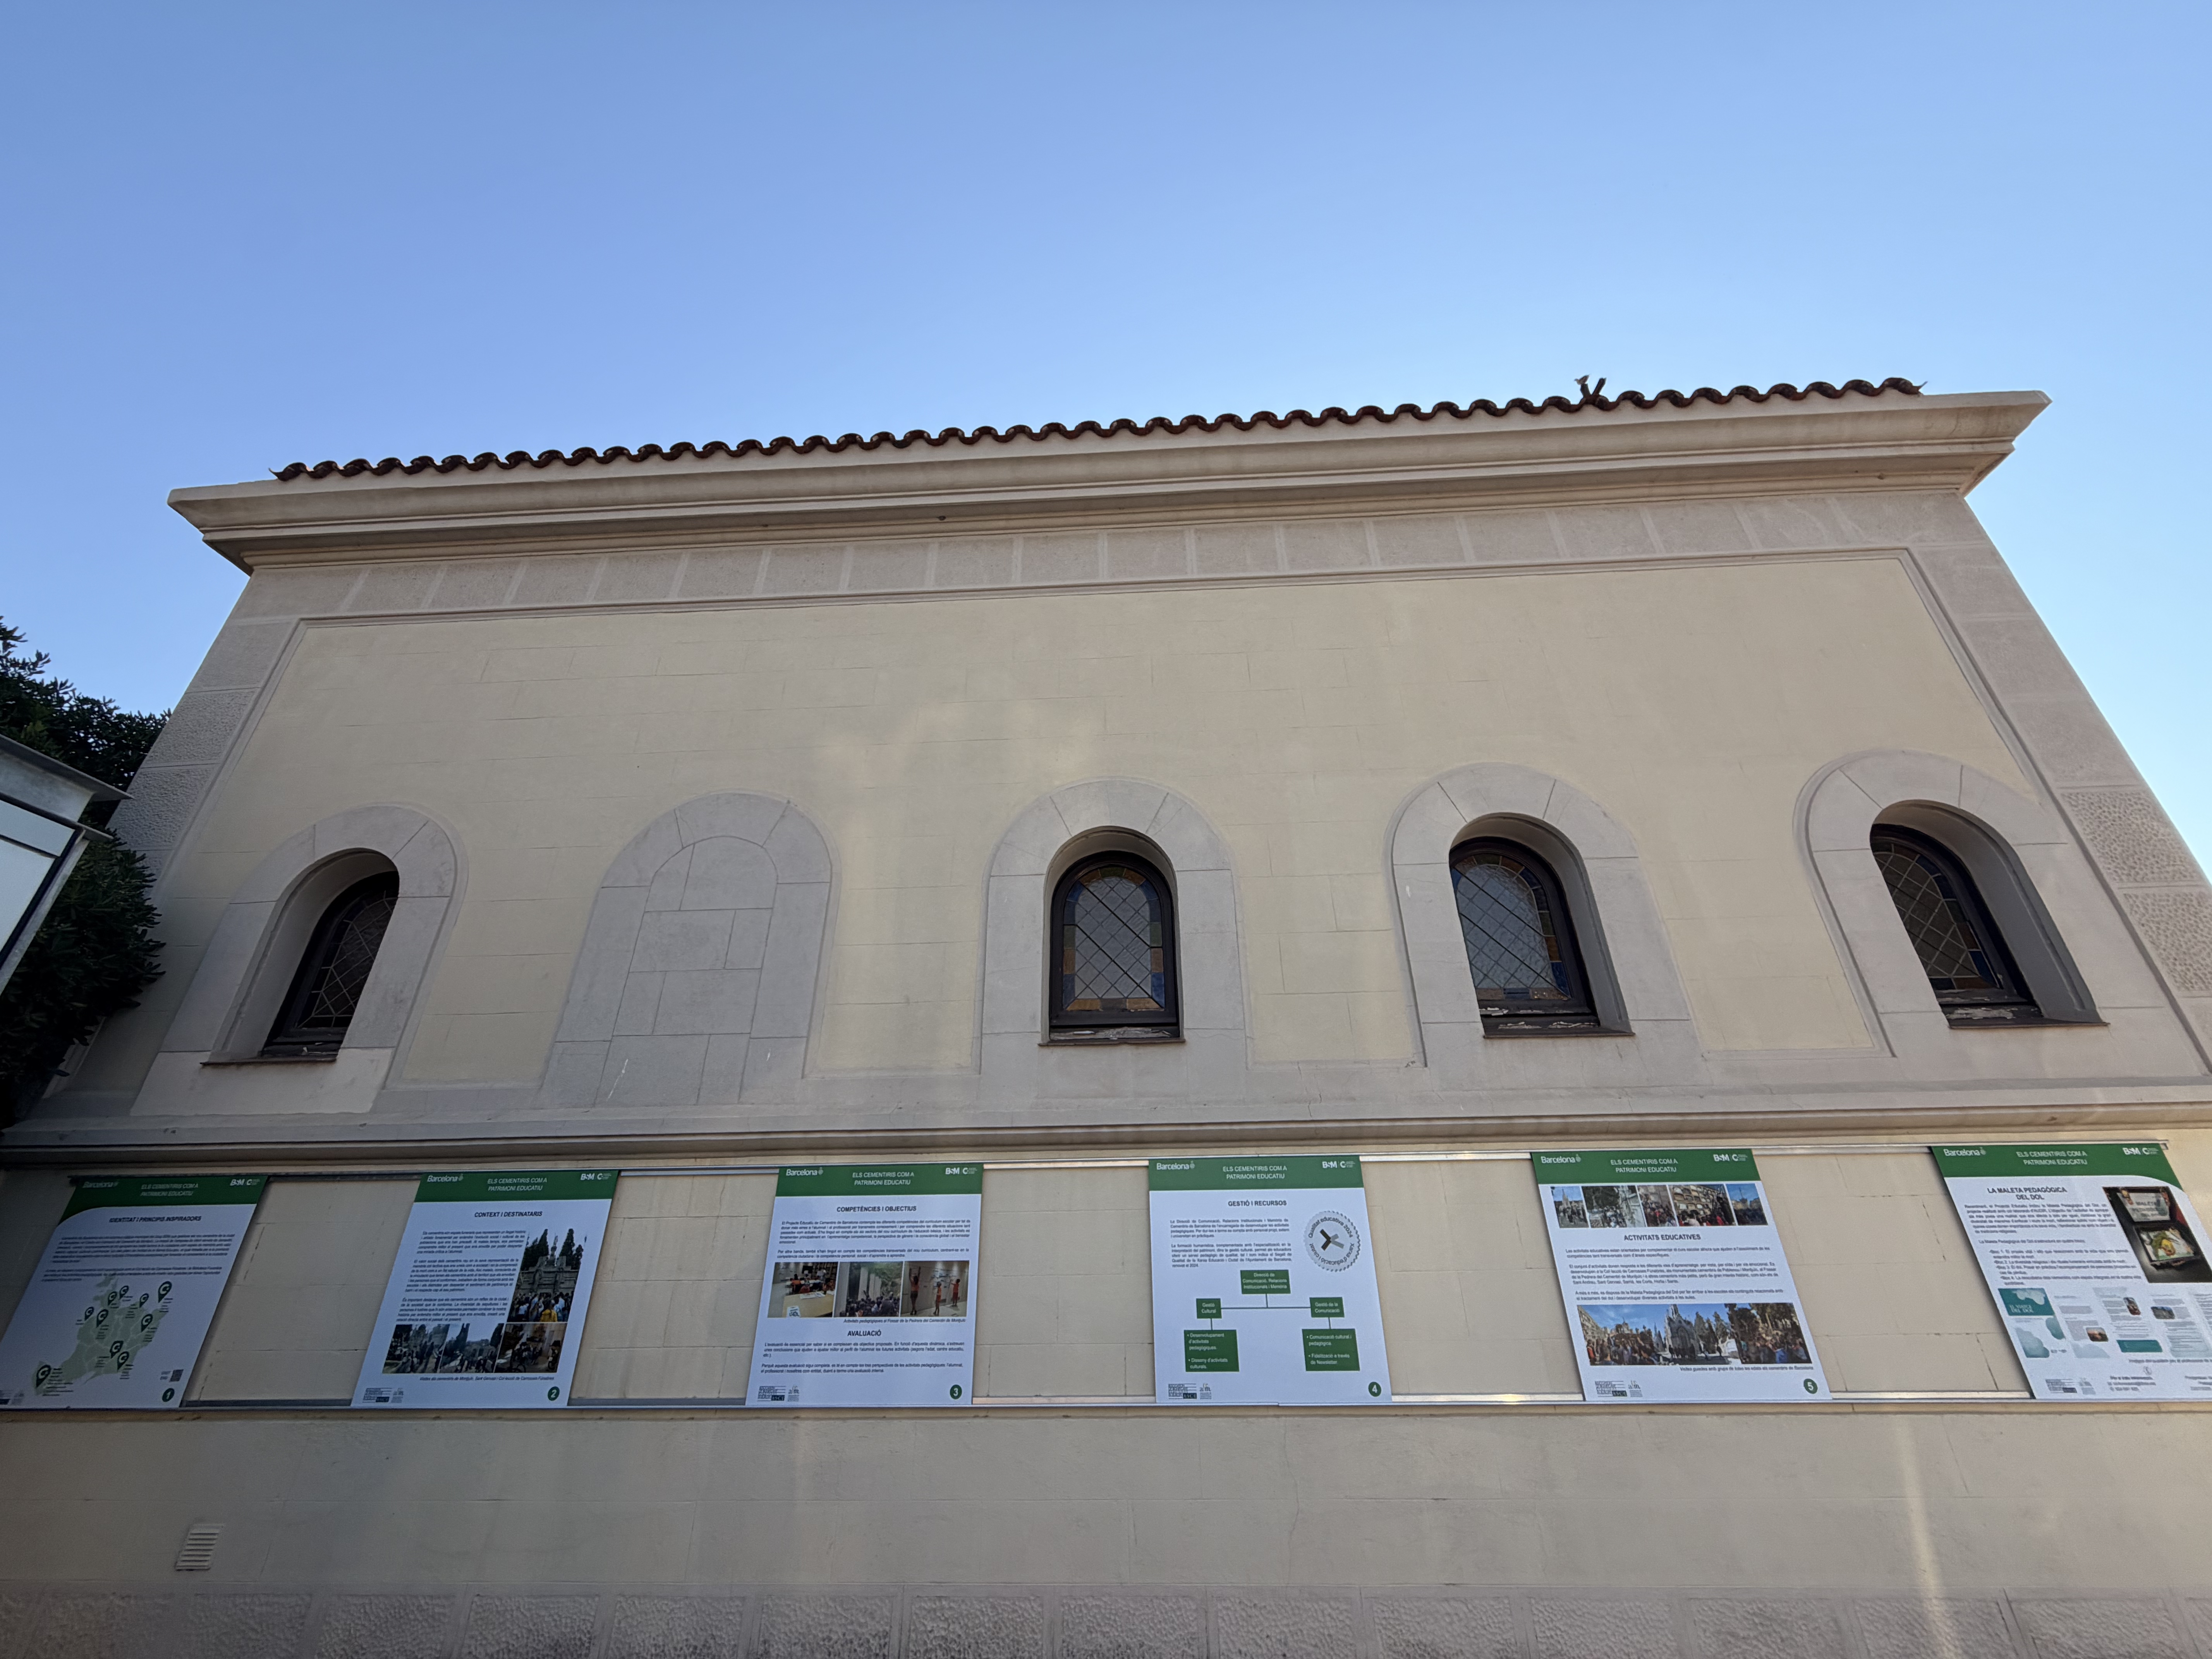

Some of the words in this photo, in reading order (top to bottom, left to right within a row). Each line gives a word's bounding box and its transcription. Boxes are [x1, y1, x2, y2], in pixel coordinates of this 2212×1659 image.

[1944, 1148, 1980, 1156] Barcelona
[1308, 1220, 1321, 1238] Qualitat
[1320, 1216, 1344, 1226] educativa
[1343, 1224, 1353, 1238] 2024
[1372, 1385, 1378, 1393] 4
[1807, 1382, 1814, 1390] 5
[551, 1389, 556, 1398] 2
[953, 1388, 958, 1397] 3
